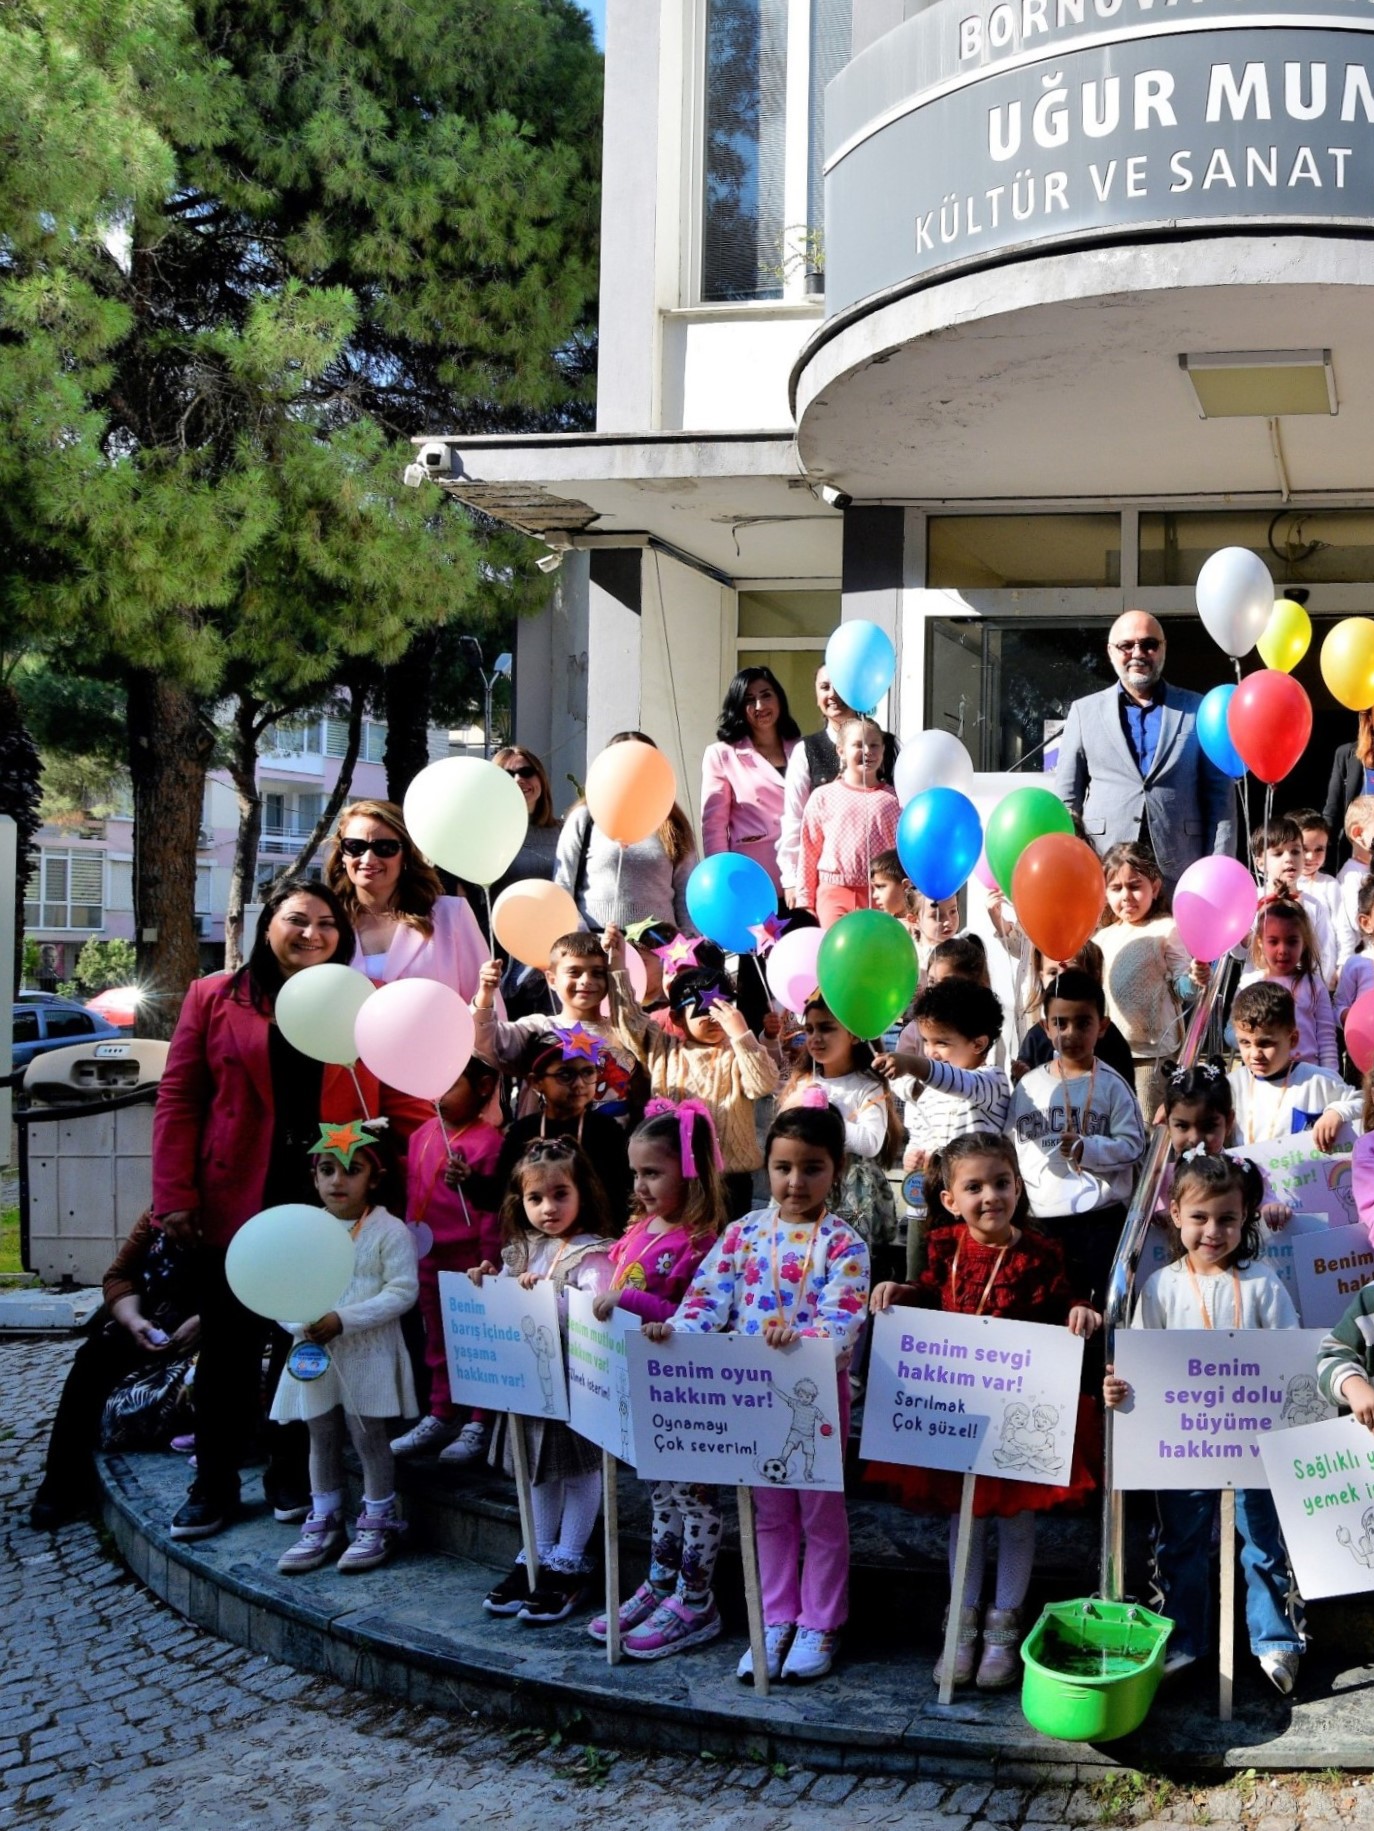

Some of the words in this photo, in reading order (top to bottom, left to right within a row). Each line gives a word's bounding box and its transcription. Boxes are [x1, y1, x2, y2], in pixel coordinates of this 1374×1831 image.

[987, 71, 1178, 162] UĞUR
[915, 169, 1070, 254] KÜLTÜR
[1089, 156, 1148, 202] VE
[1169, 146, 1352, 193] SANAT
[1282, 1168, 1318, 1188] var!
[1314, 1251, 1374, 1275] Benim
[450, 1297, 486, 1315] Benim
[451, 1319, 480, 1342] barış
[482, 1322, 521, 1342] içinde
[454, 1345, 497, 1363] yaşama
[901, 1334, 968, 1359] Benim
[975, 1347, 1032, 1370] sevgi
[456, 1365, 499, 1384] hakkım
[501, 1374, 526, 1388] var!
[594, 1355, 609, 1375] var!
[648, 1359, 714, 1379] Benim
[721, 1366, 772, 1386] oyun
[1188, 1358, 1260, 1377] Benim
[898, 1361, 975, 1387] hakkım
[982, 1376, 1024, 1393] var!
[650, 1385, 726, 1406] hakkım
[732, 1391, 773, 1408] var!
[895, 1391, 965, 1414] Sarılmak
[1165, 1386, 1224, 1408] sevgi
[1232, 1386, 1283, 1404] dolu
[652, 1413, 728, 1434] Oynamayı
[893, 1413, 923, 1431] Çok
[928, 1420, 978, 1439] güzel!
[1181, 1413, 1272, 1434] büyüme
[654, 1434, 684, 1453] Çok
[691, 1440, 757, 1455] severim!
[1159, 1440, 1243, 1458] hakkım
[1293, 1449, 1360, 1480] Sağlıklı
[1303, 1482, 1361, 1516] yemek
